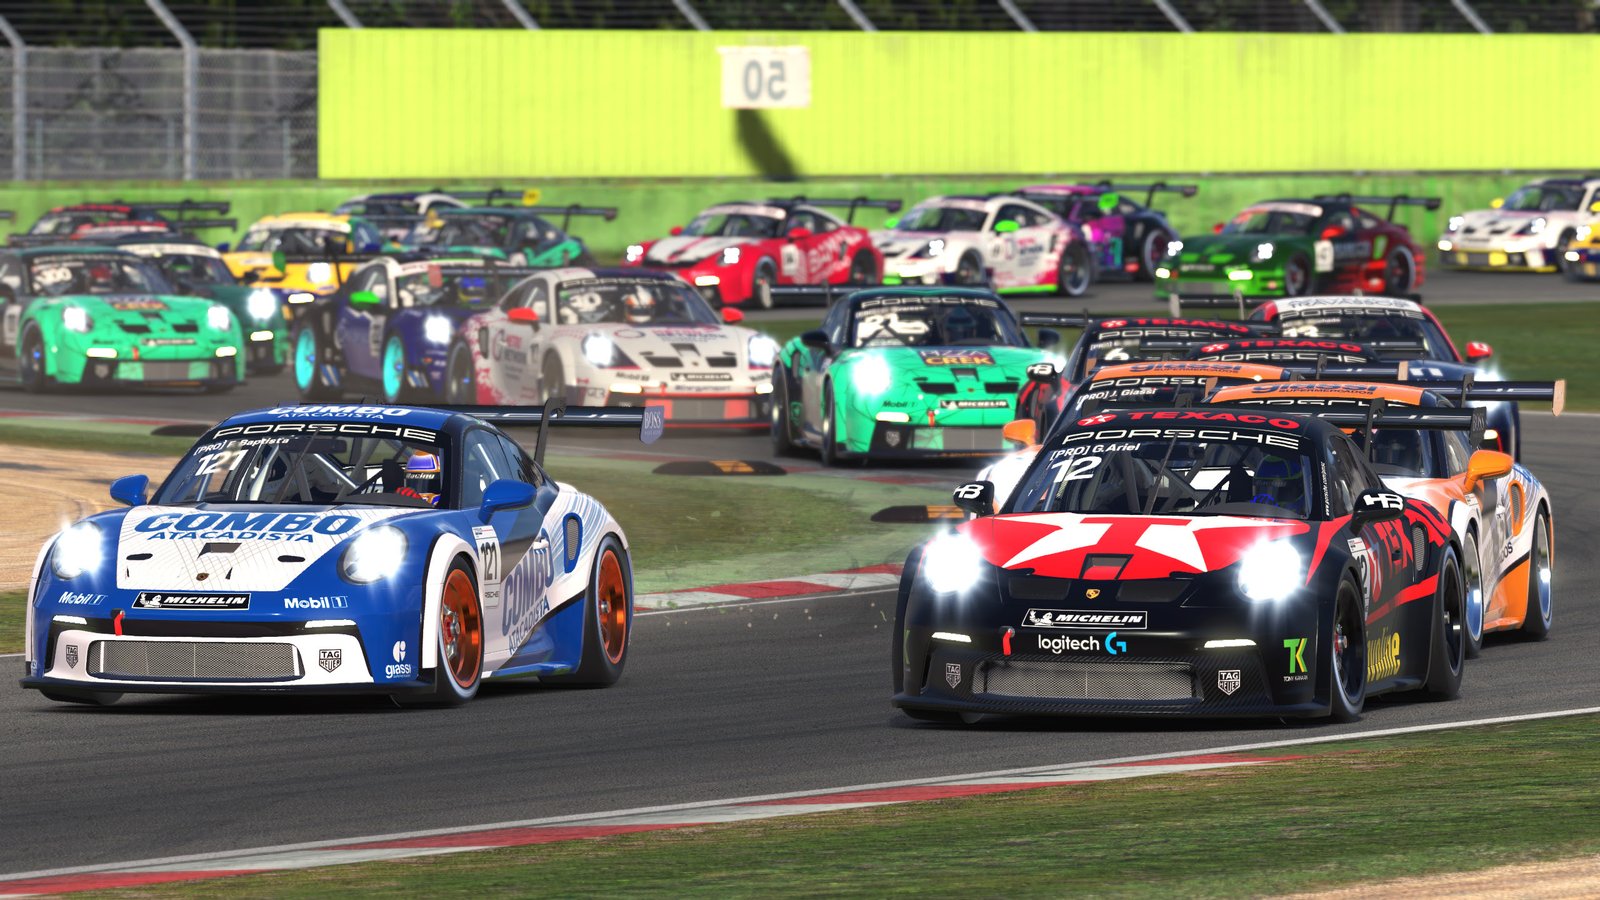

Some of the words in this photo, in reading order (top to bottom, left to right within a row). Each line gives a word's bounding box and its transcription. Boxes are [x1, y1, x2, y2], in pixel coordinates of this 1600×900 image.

[861, 296, 999, 308] PORSCHE
[1279, 307, 1426, 320] PORSCHE
[1133, 317, 1248, 333] TEXACO
[1098, 329, 1241, 340] PORSC
[1237, 340, 1361, 352] TEXACO
[925, 357, 993, 365] CREK
[278, 412, 384, 420] ATACADISTA
[644, 411, 661, 429] BOSS
[1128, 411, 1301, 429] TEXACO
[213, 424, 437, 443] PORSCHE
[1062, 429, 1300, 450] PORSCHE
[1050, 446, 1091, 461] [PRO]
[195, 449, 249, 477] 121
[1051, 456, 1102, 483] 12
[134, 512, 362, 536] COMBO
[147, 531, 315, 543] ATACADISTA
[480, 541, 498, 581] 121
[58, 591, 94, 605] Mobil
[163, 596, 247, 605] MICHELIN
[284, 596, 330, 609] Mobil
[1056, 614, 1143, 624] MICHELIN
[1038, 634, 1100, 654] logitech
[1283, 638, 1308, 674] TK
[320, 660, 340, 673] HEUER
[947, 665, 959, 674] TAG
[1221, 672, 1239, 680] TAG
[1219, 681, 1239, 694] HEUER
